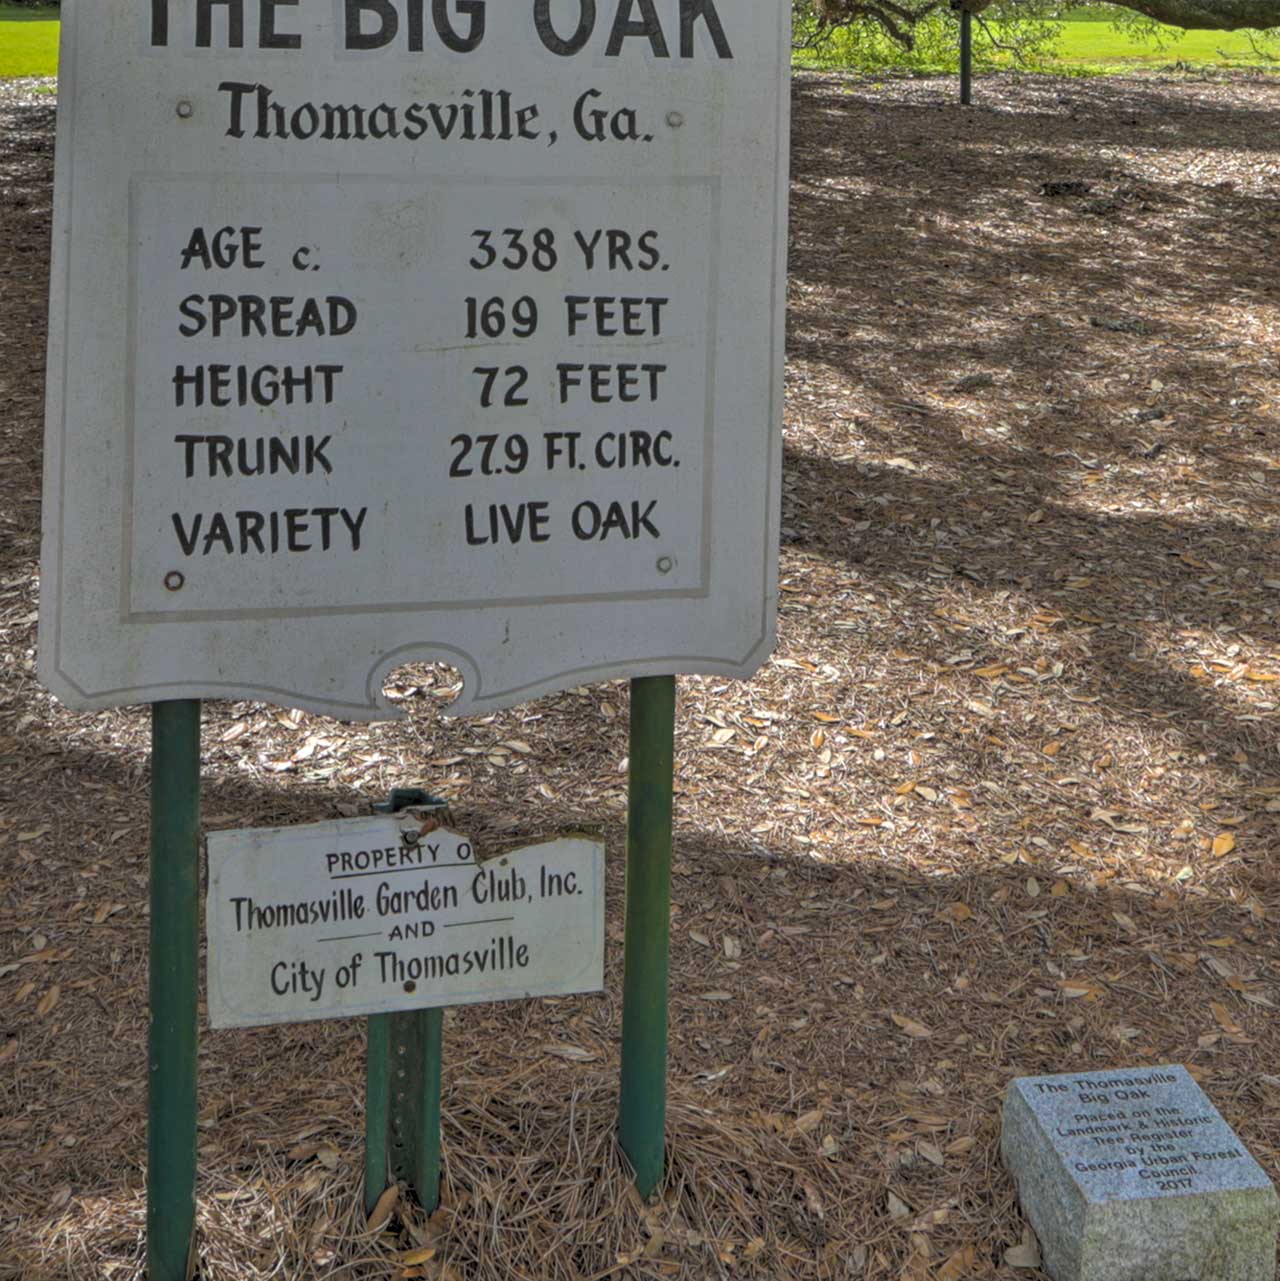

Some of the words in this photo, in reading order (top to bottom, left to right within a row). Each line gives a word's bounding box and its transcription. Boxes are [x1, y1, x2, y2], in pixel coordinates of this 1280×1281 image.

[218, 81, 558, 148] Thomasville,
[572, 89, 655, 143] Ga.
[180, 226, 265, 270] AGE
[292, 244, 322, 272] c.
[468, 228, 559, 271] 338
[573, 228, 671, 272] YRS.
[177, 294, 358, 338] SPREAD
[463, 296, 539, 340] 169
[565, 296, 669, 338] FEET
[173, 364, 344, 406] HEIGHT
[472, 366, 529, 408] 72
[555, 362, 667, 404] FEET
[174, 434, 334, 479] TRUNK
[448, 432, 529, 478] 27.9
[544, 430, 587, 472] FT.
[594, 429, 682, 470] CIRC.
[172, 506, 369, 555] VARIETY
[464, 502, 550, 546] LIVE
[570, 499, 660, 542] OAK
[326, 844, 441, 873] PROPERTY
[457, 842, 471, 861] O
[230, 889, 365, 931] Thomasville
[377, 881, 458, 916] Garden
[472, 868, 532, 904] Club,
[540, 865, 583, 898] Inc.
[388, 921, 435, 940] AND
[270, 953, 325, 1001] City
[335, 954, 362, 988] of
[374, 937, 529, 983] Thomasville
[1034, 1083, 1069, 1095] The
[1073, 1073, 1177, 1090] Thomasville
[1079, 1092, 1110, 1104] Big
[1114, 1089, 1151, 1101] Oak
[1056, 1122, 1130, 1137] Landmark
[1139, 1121, 1148, 1129] &
[1156, 1115, 1212, 1128] Historic
[1074, 1111, 1126, 1124] Placed
[1132, 1110, 1151, 1119] on
[1155, 1106, 1180, 1116] the
[1094, 1136, 1124, 1146] Tree
[1131, 1130, 1193, 1144] Register
[1126, 1146, 1145, 1155] by
[1151, 1143, 1176, 1152] the
[1075, 1159, 1136, 1173] Georgia
[1142, 1154, 1187, 1166] Urban
[1192, 1148, 1243, 1161] Forest
[1138, 1166, 1198, 1180] Council
[1157, 1180, 1193, 1191] 2017
